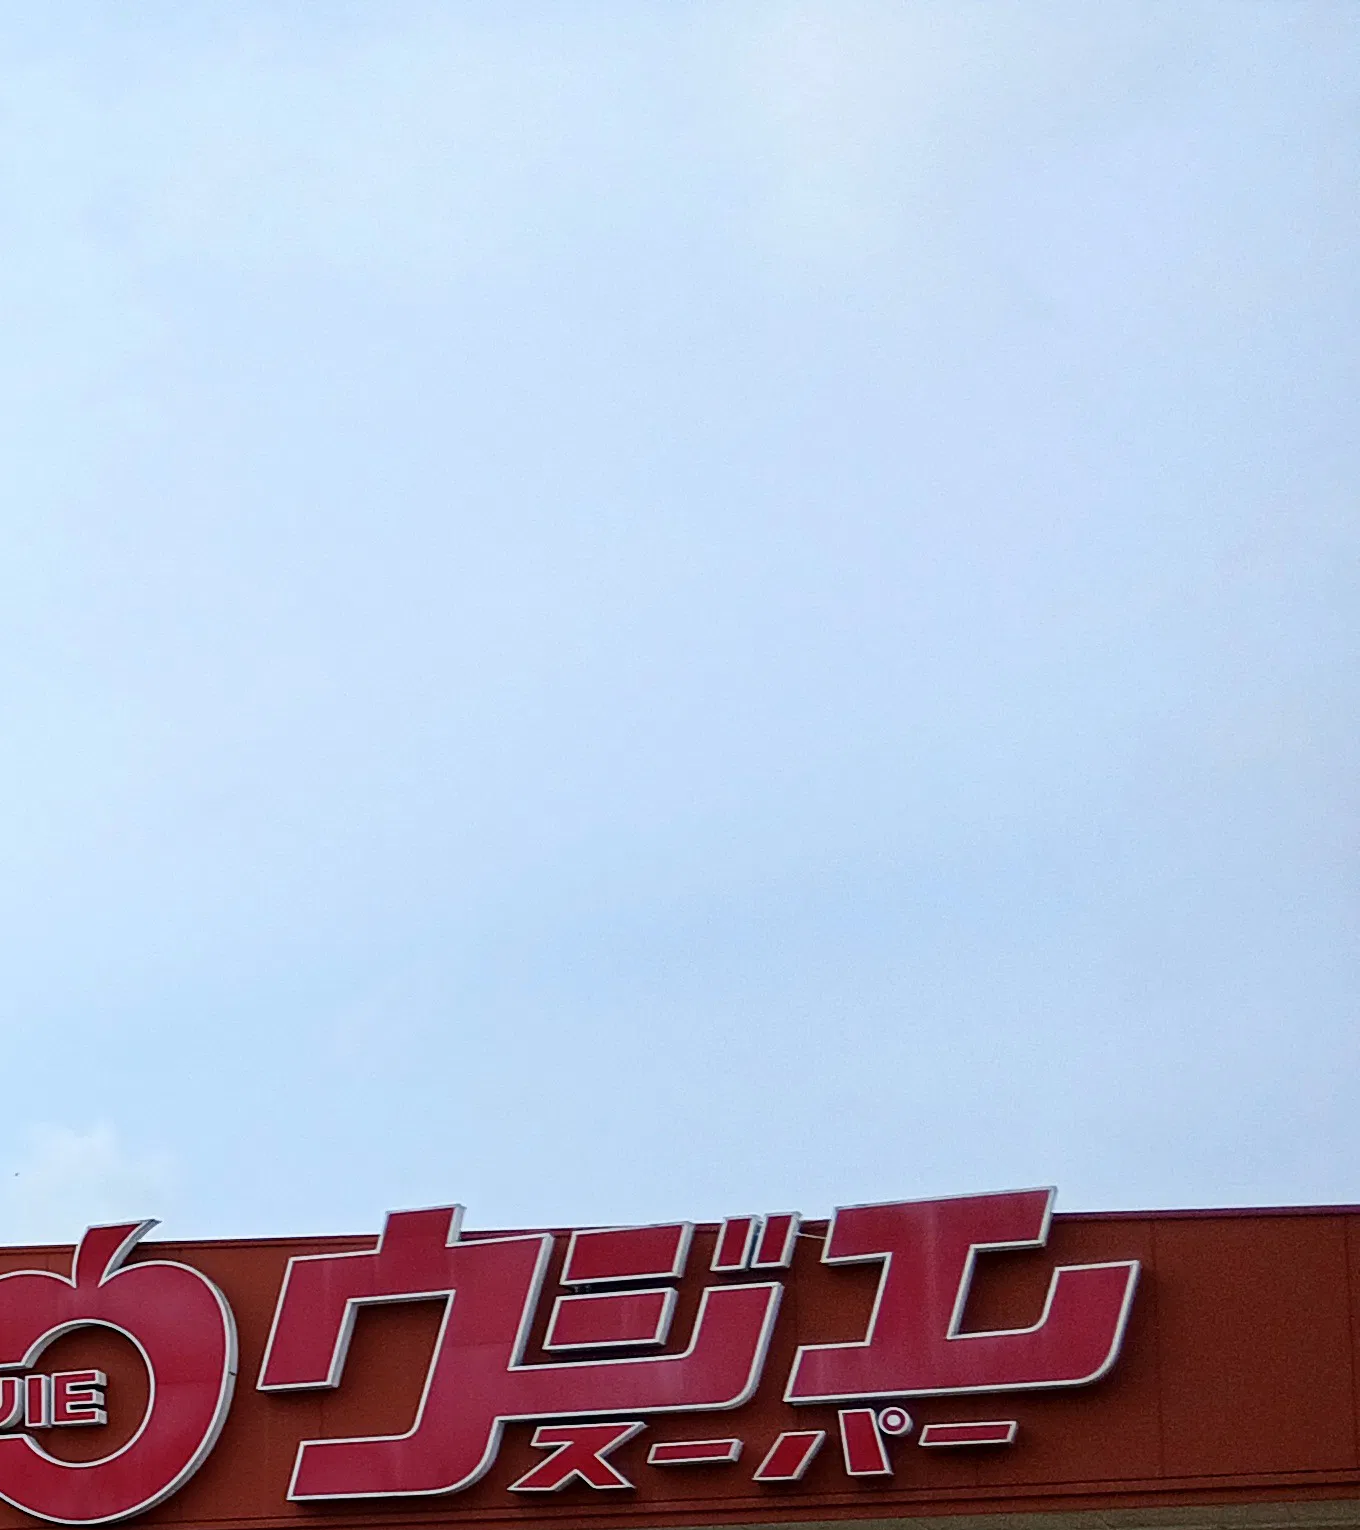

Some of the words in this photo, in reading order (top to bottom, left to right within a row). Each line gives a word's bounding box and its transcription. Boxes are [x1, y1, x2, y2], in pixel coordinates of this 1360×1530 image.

[256, 1186, 1140, 1500] ウジエ
[507, 1406, 1018, 1492] スーパー
